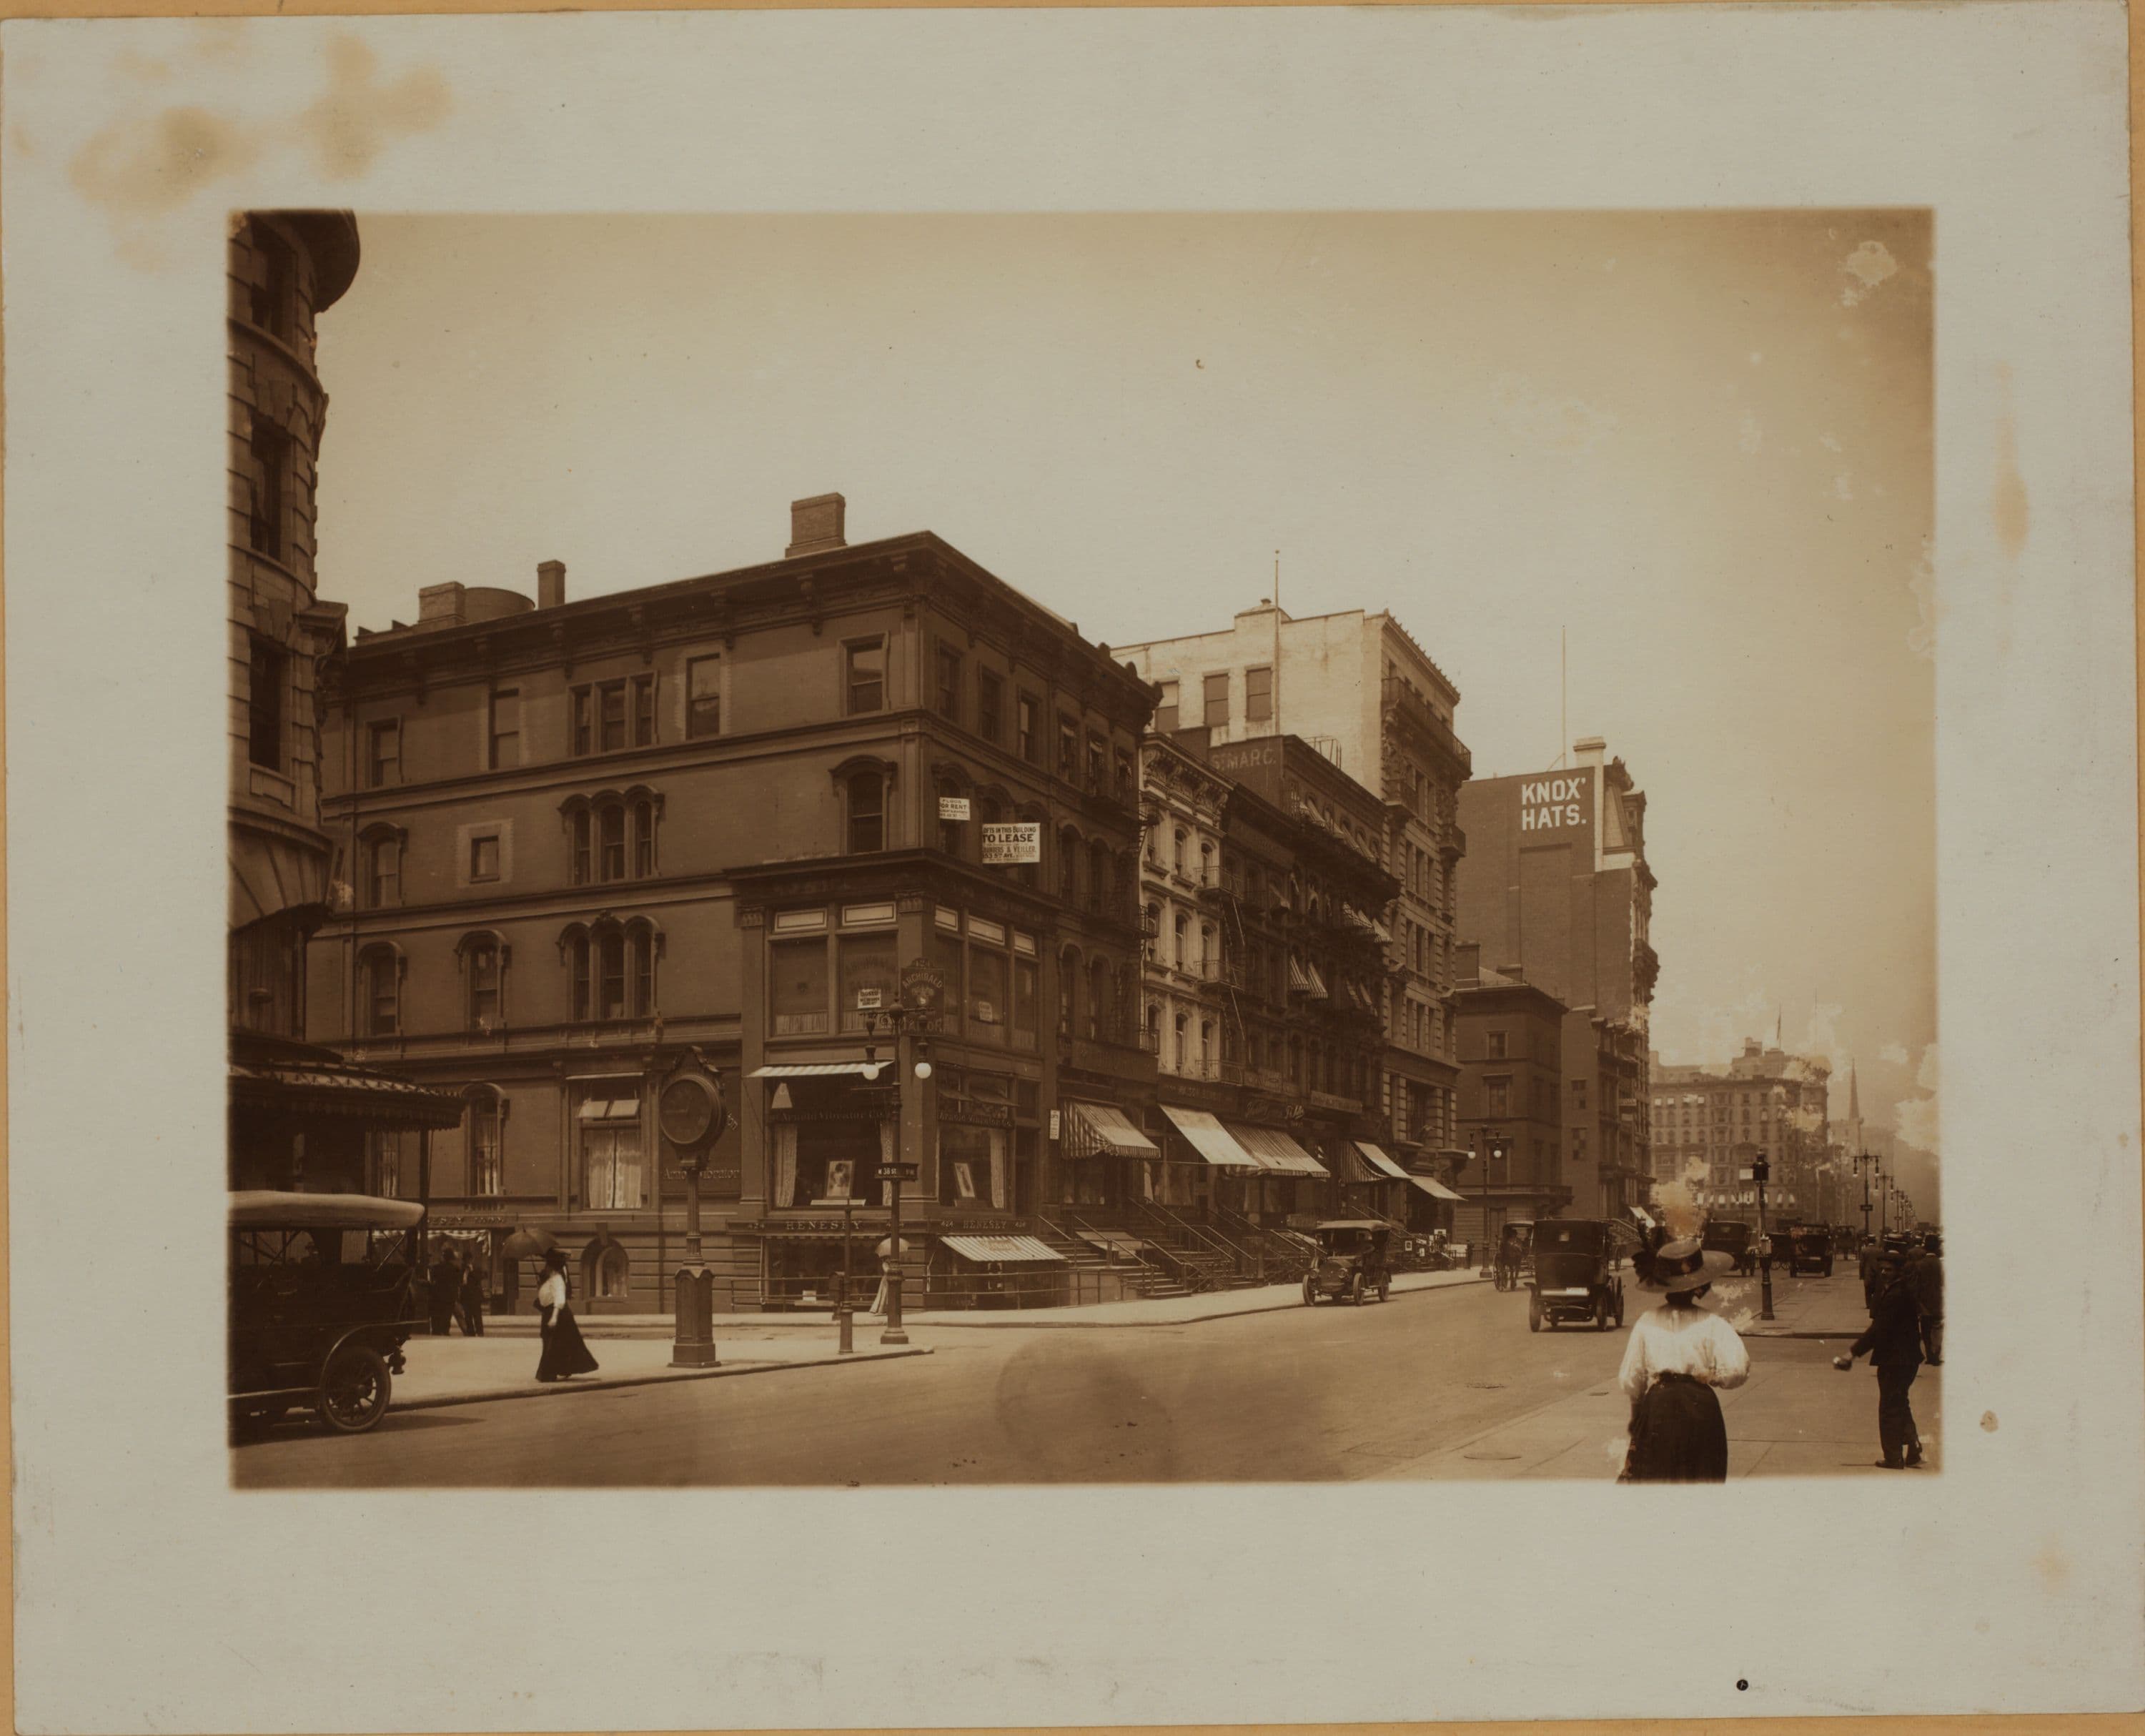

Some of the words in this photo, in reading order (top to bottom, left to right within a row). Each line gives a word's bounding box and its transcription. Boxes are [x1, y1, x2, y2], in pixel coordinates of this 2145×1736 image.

[1522, 804, 1586, 830] HATS.
[983, 834, 996, 843] TO
[999, 833, 1034, 843] LEASE
[902, 972, 943, 989] ARCHIBALD
